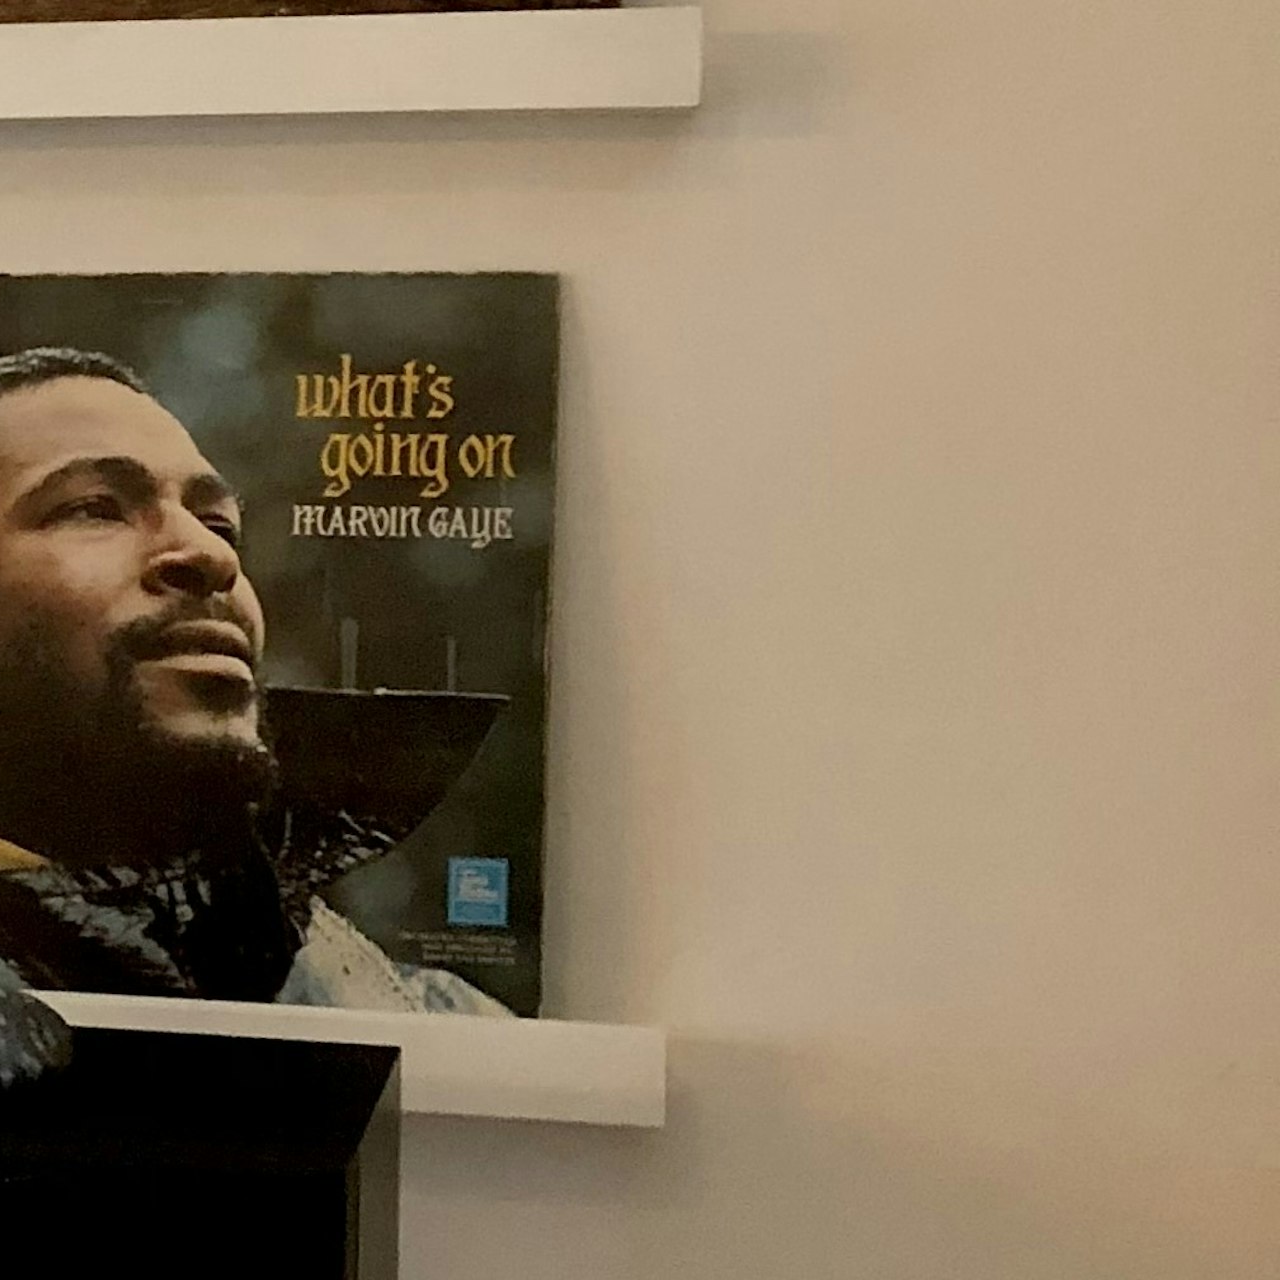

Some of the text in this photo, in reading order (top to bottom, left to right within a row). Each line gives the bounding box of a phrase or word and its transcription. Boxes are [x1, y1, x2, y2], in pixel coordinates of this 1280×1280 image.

[296, 353, 454, 418] what's
[320, 422, 516, 498] going on
